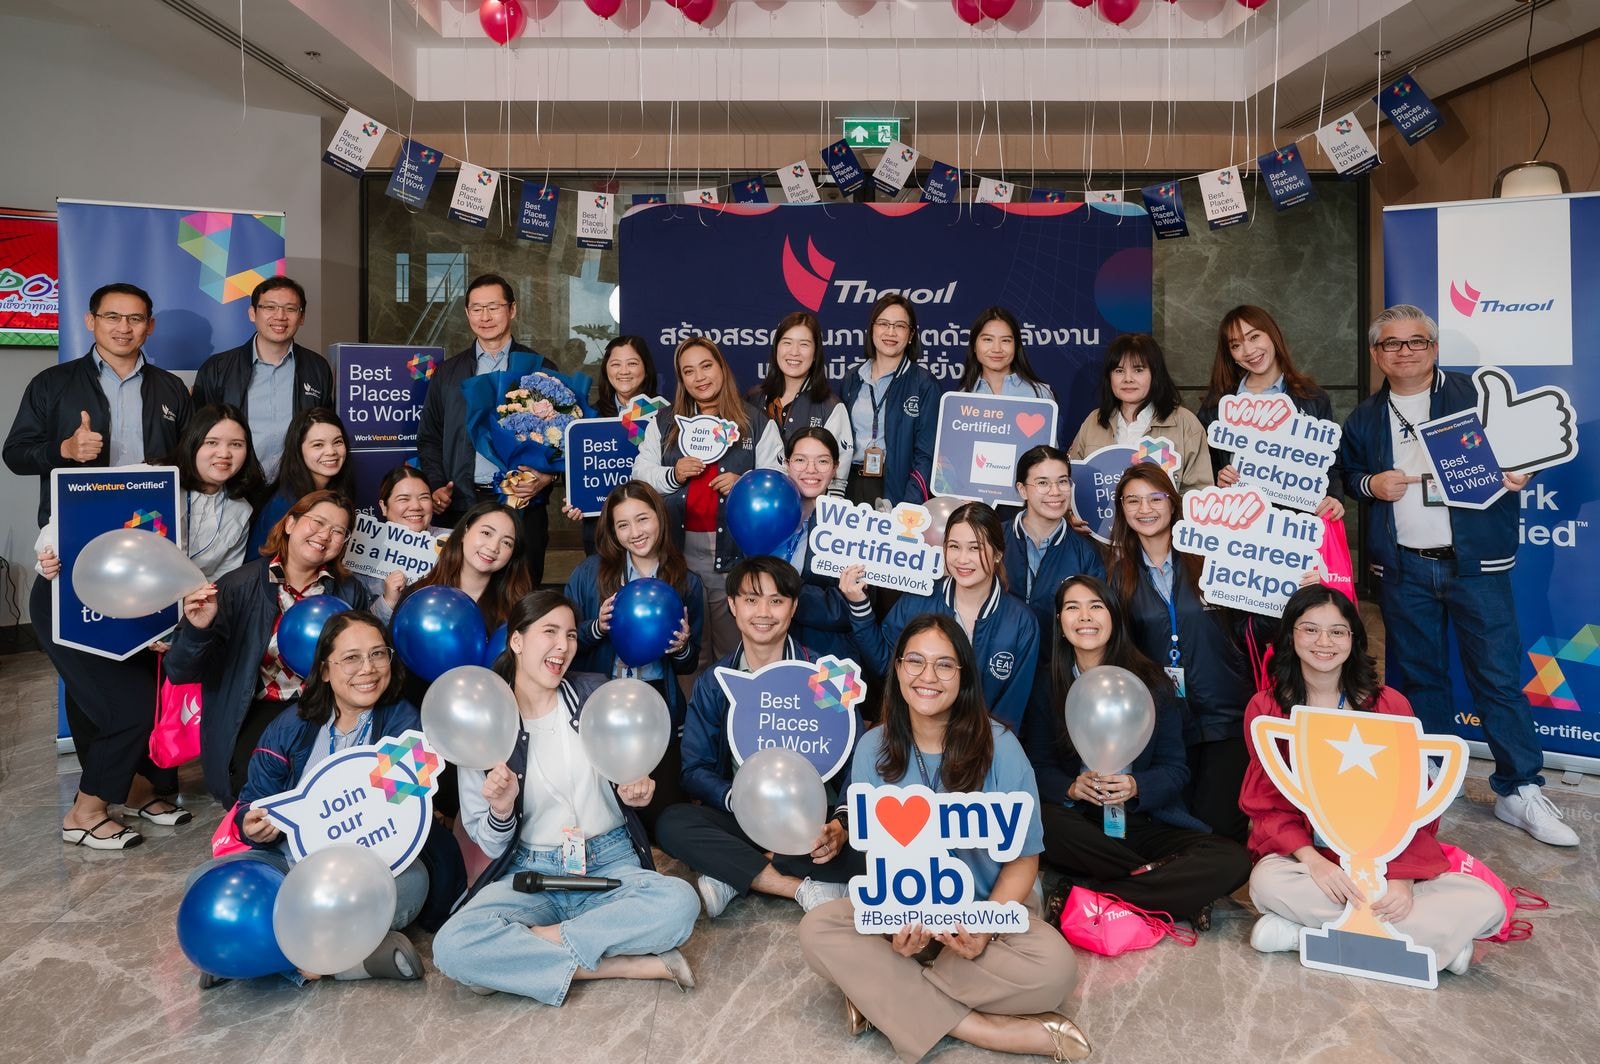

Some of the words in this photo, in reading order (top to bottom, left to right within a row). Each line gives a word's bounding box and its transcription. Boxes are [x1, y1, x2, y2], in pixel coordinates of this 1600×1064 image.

[1391, 102, 1410, 116] Best
[1396, 105, 1422, 122] Places
[1402, 122, 1411, 130] to
[1410, 109, 1431, 124] Work
[342, 130, 359, 142] Best
[339, 137, 362, 153] Places
[1331, 141, 1348, 153] Best
[1335, 144, 1360, 160] Places
[345, 150, 364, 162] Work
[1349, 149, 1368, 162] Work
[402, 160, 418, 172] Best
[832, 162, 845, 172] Best
[836, 166, 853, 178] Places
[844, 170, 859, 181] Work
[1269, 170, 1287, 180] Best
[1272, 175, 1297, 188] Places
[406, 180, 426, 191] Work
[461, 184, 476, 194] Best
[930, 179, 943, 189] Best
[1285, 180, 1304, 193] Work
[459, 192, 482, 203] Places
[1208, 191, 1224, 200] Best
[1210, 197, 1233, 208] Places
[466, 202, 485, 212] Work
[525, 202, 540, 210] Best
[1221, 203, 1240, 213] Work
[524, 209, 547, 220] Places
[1164, 217, 1180, 225] Work
[532, 219, 550, 228] Work
[1480, 299, 1554, 313] Thaioil
[350, 364, 392, 381] Best
[350, 385, 411, 401] Places
[349, 406, 368, 422] to
[960, 405, 980, 416] We
[983, 408, 1004, 419] are
[692, 426, 710, 435] Join
[952, 420, 1010, 435] Certified!
[1290, 418, 1299, 436] I
[1305, 422, 1335, 445] hit
[584, 439, 617, 453] Best
[690, 444, 712, 452] team!
[1214, 426, 1248, 448] the
[1255, 439, 1329, 468] career
[584, 456, 634, 470] Places
[1440, 454, 1468, 470] Best
[1237, 457, 1323, 493] jackpot
[1445, 464, 1485, 482] Places
[68, 483, 125, 492] WorkVenture
[583, 475, 600, 488] to
[1450, 483, 1462, 494] to
[1521, 484, 1559, 510] rk
[821, 502, 892, 536] We're
[1097, 506, 1113, 518] to
[357, 518, 382, 539] My
[388, 526, 431, 550] Work
[1266, 514, 1274, 533] I
[1282, 517, 1317, 542] hit
[350, 539, 365, 554] is
[370, 547, 379, 559] a
[1180, 526, 1219, 551] the
[1227, 540, 1313, 570] career
[1206, 561, 1301, 597] jackpo
[82, 606, 103, 622] to
[760, 692, 800, 710] Best
[760, 713, 818, 731] Places
[758, 736, 776, 750] to
[319, 787, 367, 820] Join
[328, 812, 363, 840] our
[856, 794, 868, 839] I
[939, 803, 1023, 850] my
[356, 818, 398, 848] am!
[858, 857, 964, 905] Job
[862, 910, 1020, 926] #BestPlacestoWork
